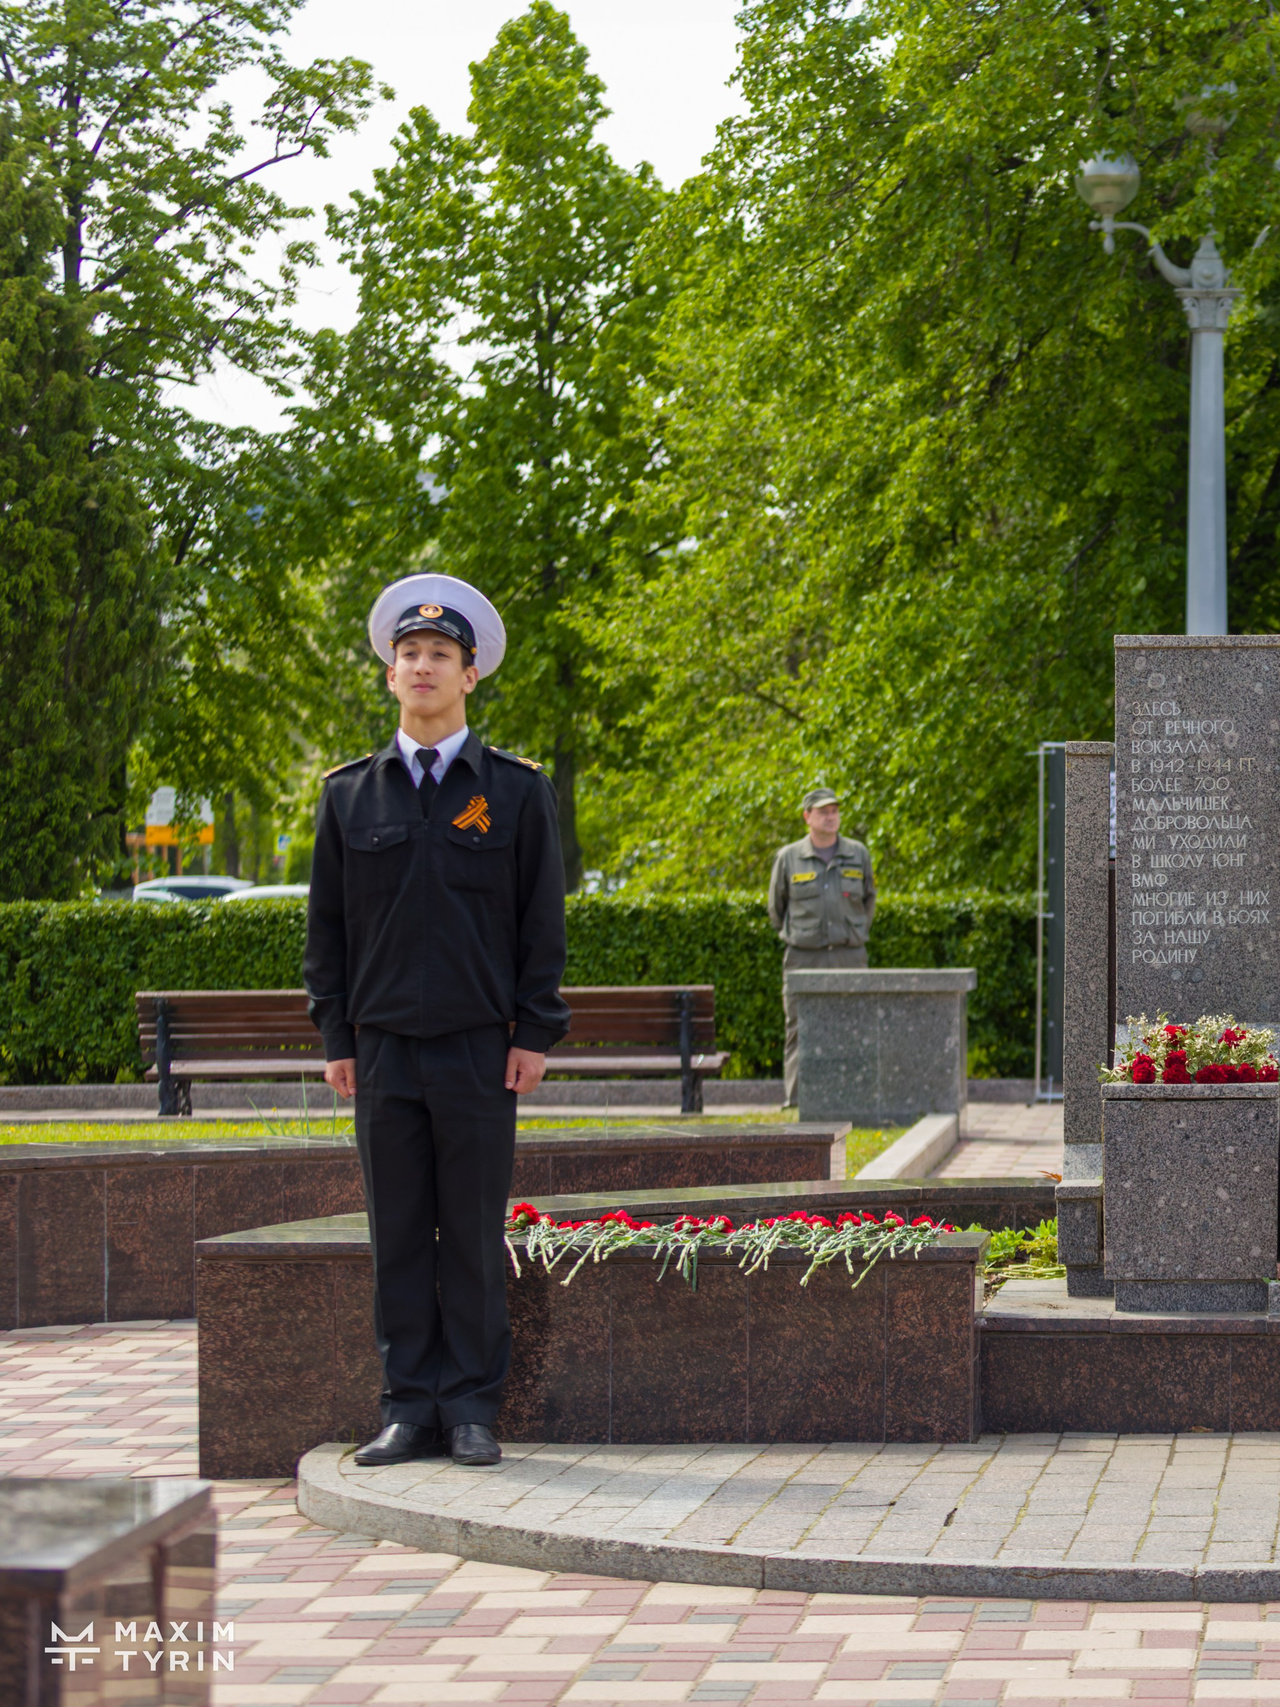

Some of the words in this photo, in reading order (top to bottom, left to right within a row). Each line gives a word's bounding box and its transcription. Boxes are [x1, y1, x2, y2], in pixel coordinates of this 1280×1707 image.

[1131, 701, 1181, 716] ЗДЕСЬ
[1131, 720, 1153, 735] ОТ
[1165, 719, 1234, 735] РЕЧНОГО
[1131, 739, 1210, 754] ВОКЗАЛА
[1131, 759, 1141, 773] В
[1131, 777, 1182, 793] БОЛЕЕ
[1194, 777, 1230, 792] 700
[1132, 796, 1229, 811] МАЛЬЧИШЕК
[1131, 814, 1253, 831] ДОБРОВОЛЬЦА
[1132, 836, 1156, 850] МИ
[1167, 834, 1247, 850] УХОДИЛИ
[1131, 854, 1141, 869] В
[1150, 854, 1204, 868] ШКОЛУ
[1213, 853, 1248, 868] ЮНГ
[1131, 873, 1168, 888] ВМФ
[1132, 891, 1196, 907] МНОГИЕ
[1206, 891, 1227, 906] ИЗ
[1240, 890, 1270, 905] НИХ
[1131, 911, 1207, 926] ПОГИБЛИ
[1213, 910, 1222, 924] В
[1228, 909, 1270, 924] БОЯХ
[1132, 930, 1156, 944] ЗА
[1164, 929, 1211, 944] НАШУ
[1132, 949, 1198, 964] РОДИНУ
